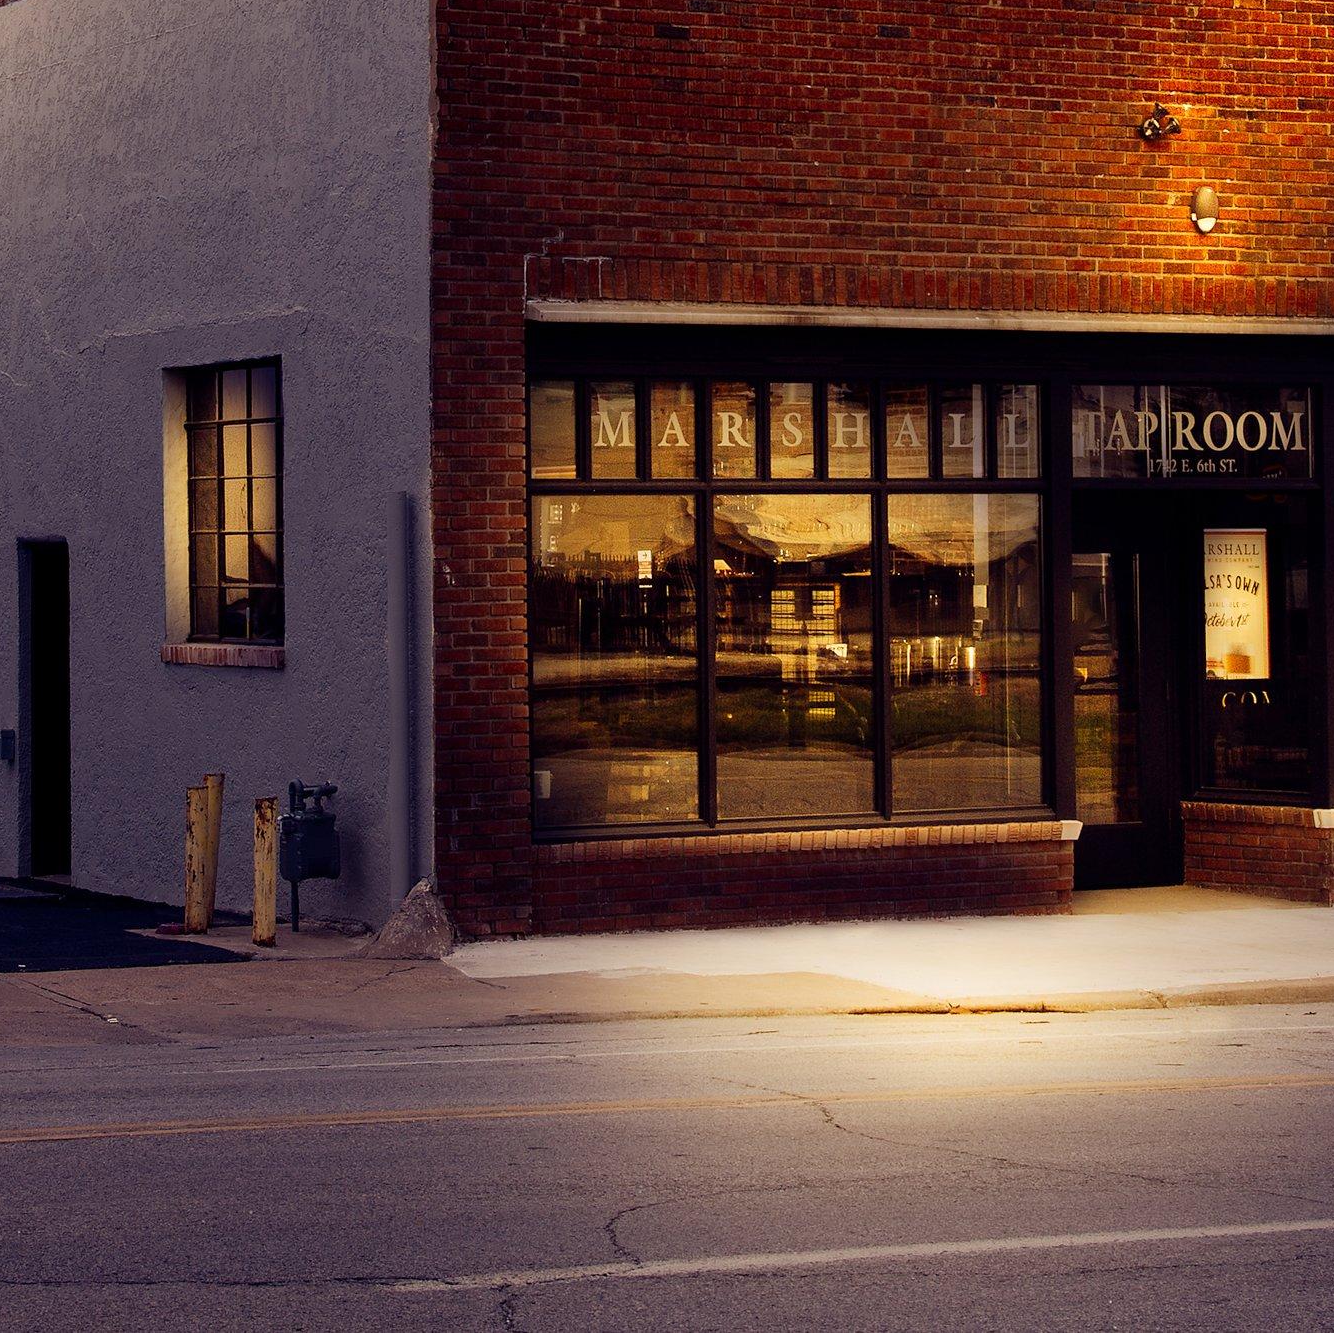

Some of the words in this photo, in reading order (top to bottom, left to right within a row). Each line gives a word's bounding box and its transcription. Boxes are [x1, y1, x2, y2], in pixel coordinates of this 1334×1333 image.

[594, 411, 1031, 448] MARSHALL
[1081, 410, 1159, 451] TAP
[1171, 410, 1307, 452] ROOM
[1181, 458, 1193, 473] E.
[1197, 458, 1216, 473] 6th
[1219, 458, 1238, 473] ST.
[1204, 543, 1260, 556] RSHALL
[1235, 575, 1260, 596] OWN
